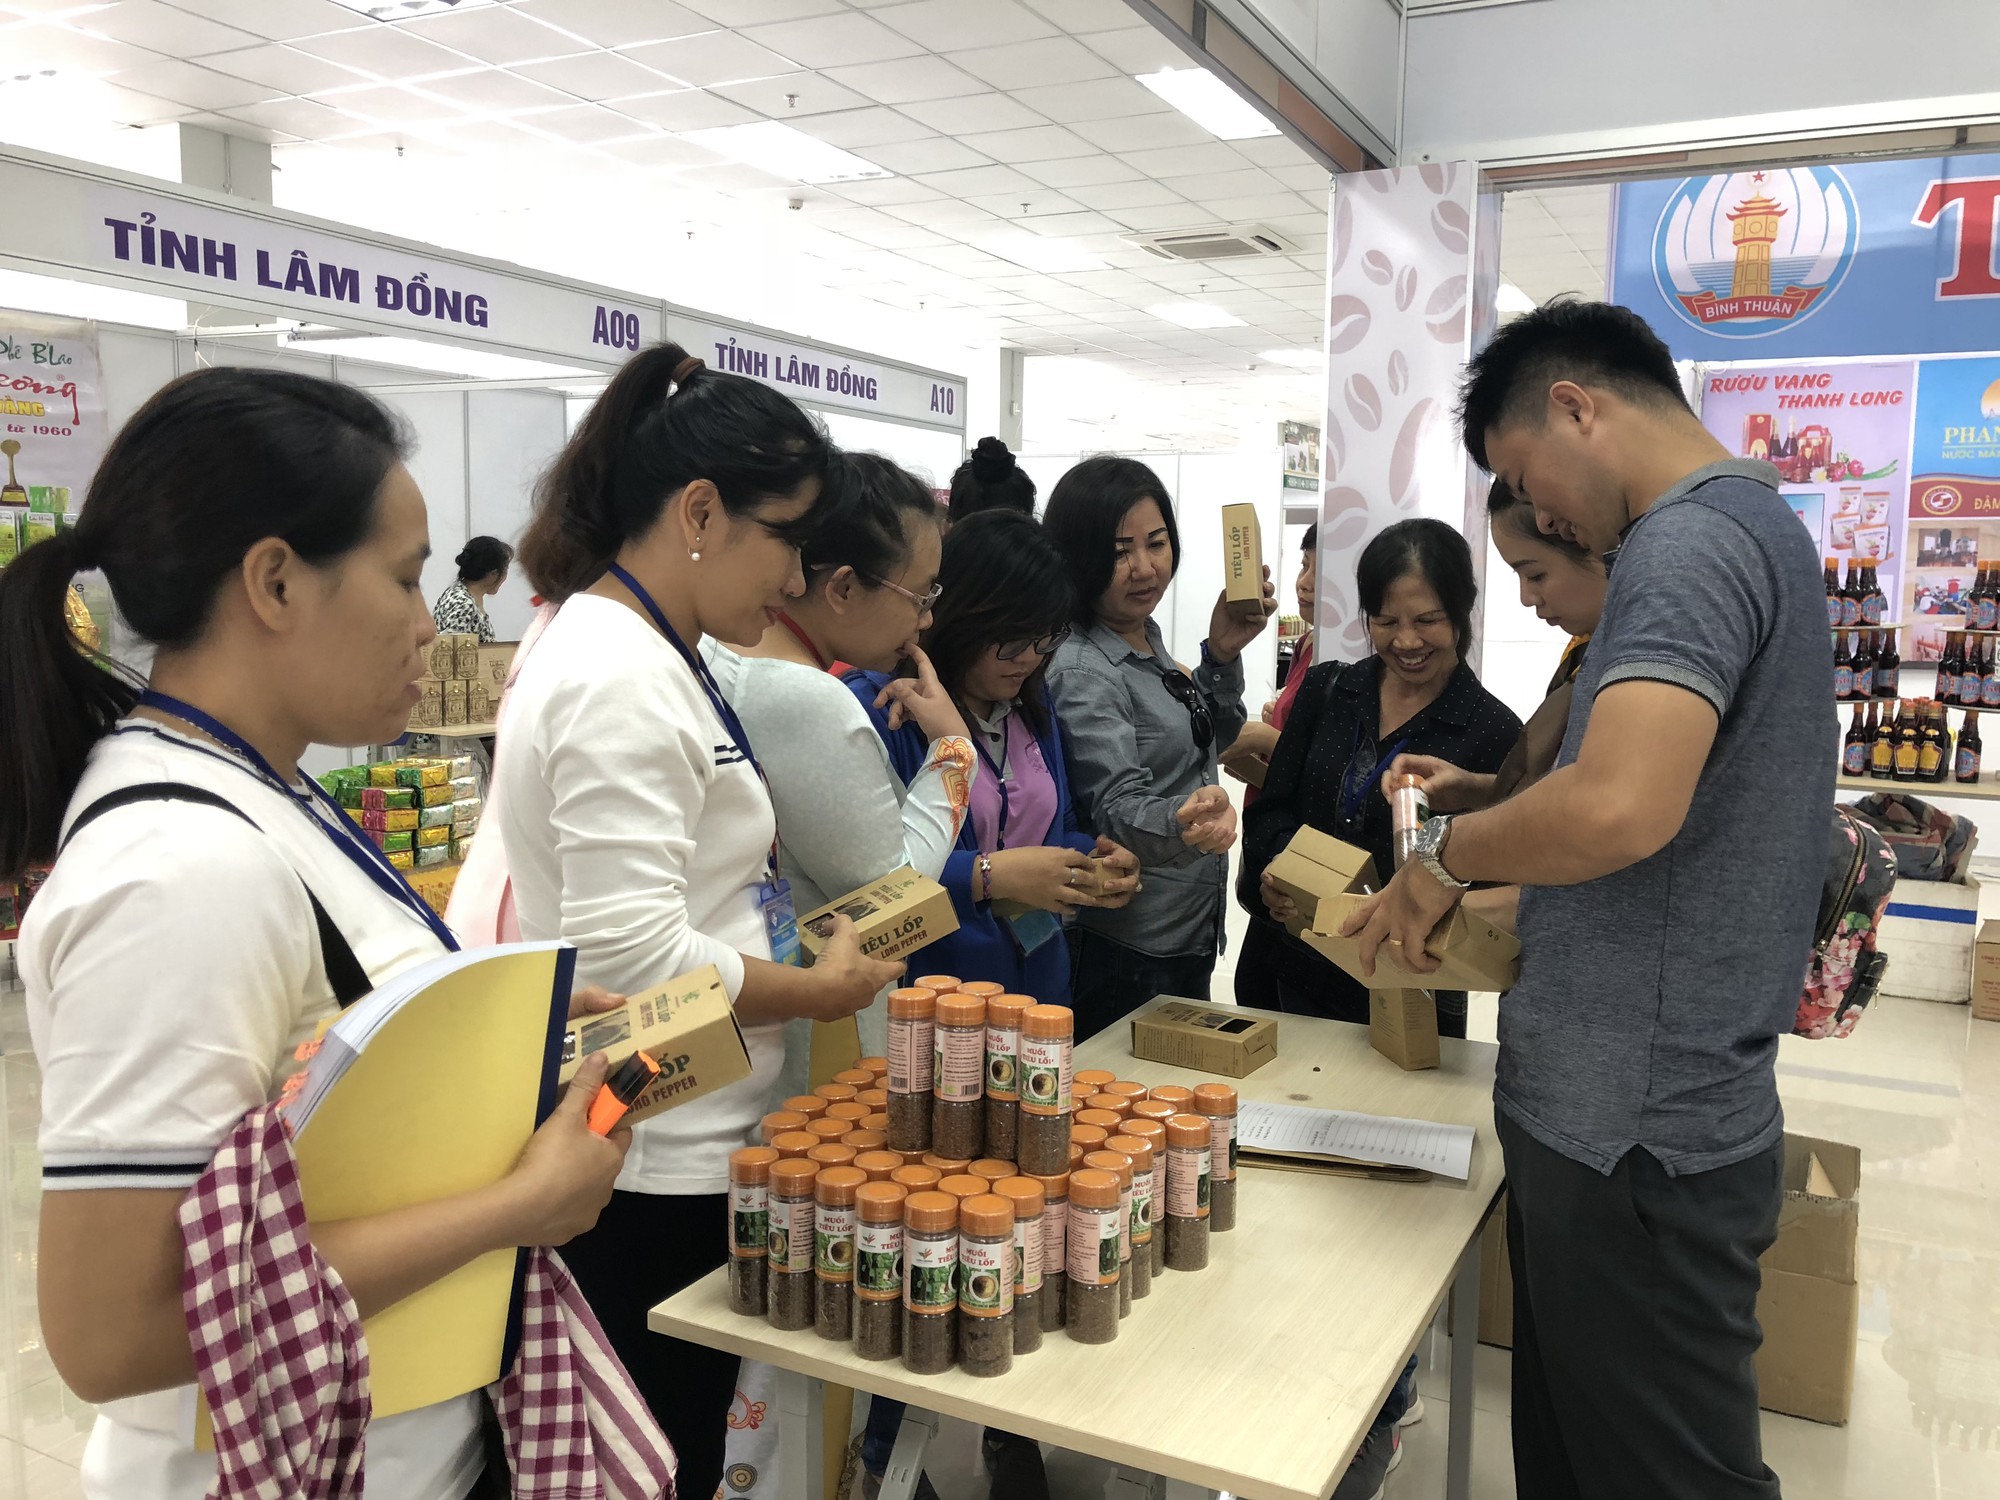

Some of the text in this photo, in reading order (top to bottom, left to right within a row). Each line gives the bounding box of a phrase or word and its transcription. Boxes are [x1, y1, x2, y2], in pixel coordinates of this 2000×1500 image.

[104, 211, 488, 328] TỈNH LÂM ĐỒNG
[1705, 298, 1792, 318] BÌNH THUẬN
[592, 305, 640, 351] A09
[715, 337, 877, 401] TỈNH LÂM ĐỒNG
[1710, 373, 1832, 395] RƯỢU VANG
[930, 383, 954, 415] A10
[1778, 390, 1904, 409] THANH LONG
[33, 425, 72, 437] 1960
[1228, 526, 1242, 579] TIÊU LỐP
[893, 915, 924, 939] LỐP
[900, 929, 928, 949] PEPPER
[652, 1075, 698, 1103] PEPPER
[824, 1215, 845, 1224] MUỐI
[837, 1223, 853, 1232] LỐP
[881, 1241, 900, 1250] TIÊU
[966, 1247, 987, 1257] MUỐI
[978, 1257, 995, 1266] LỐP
